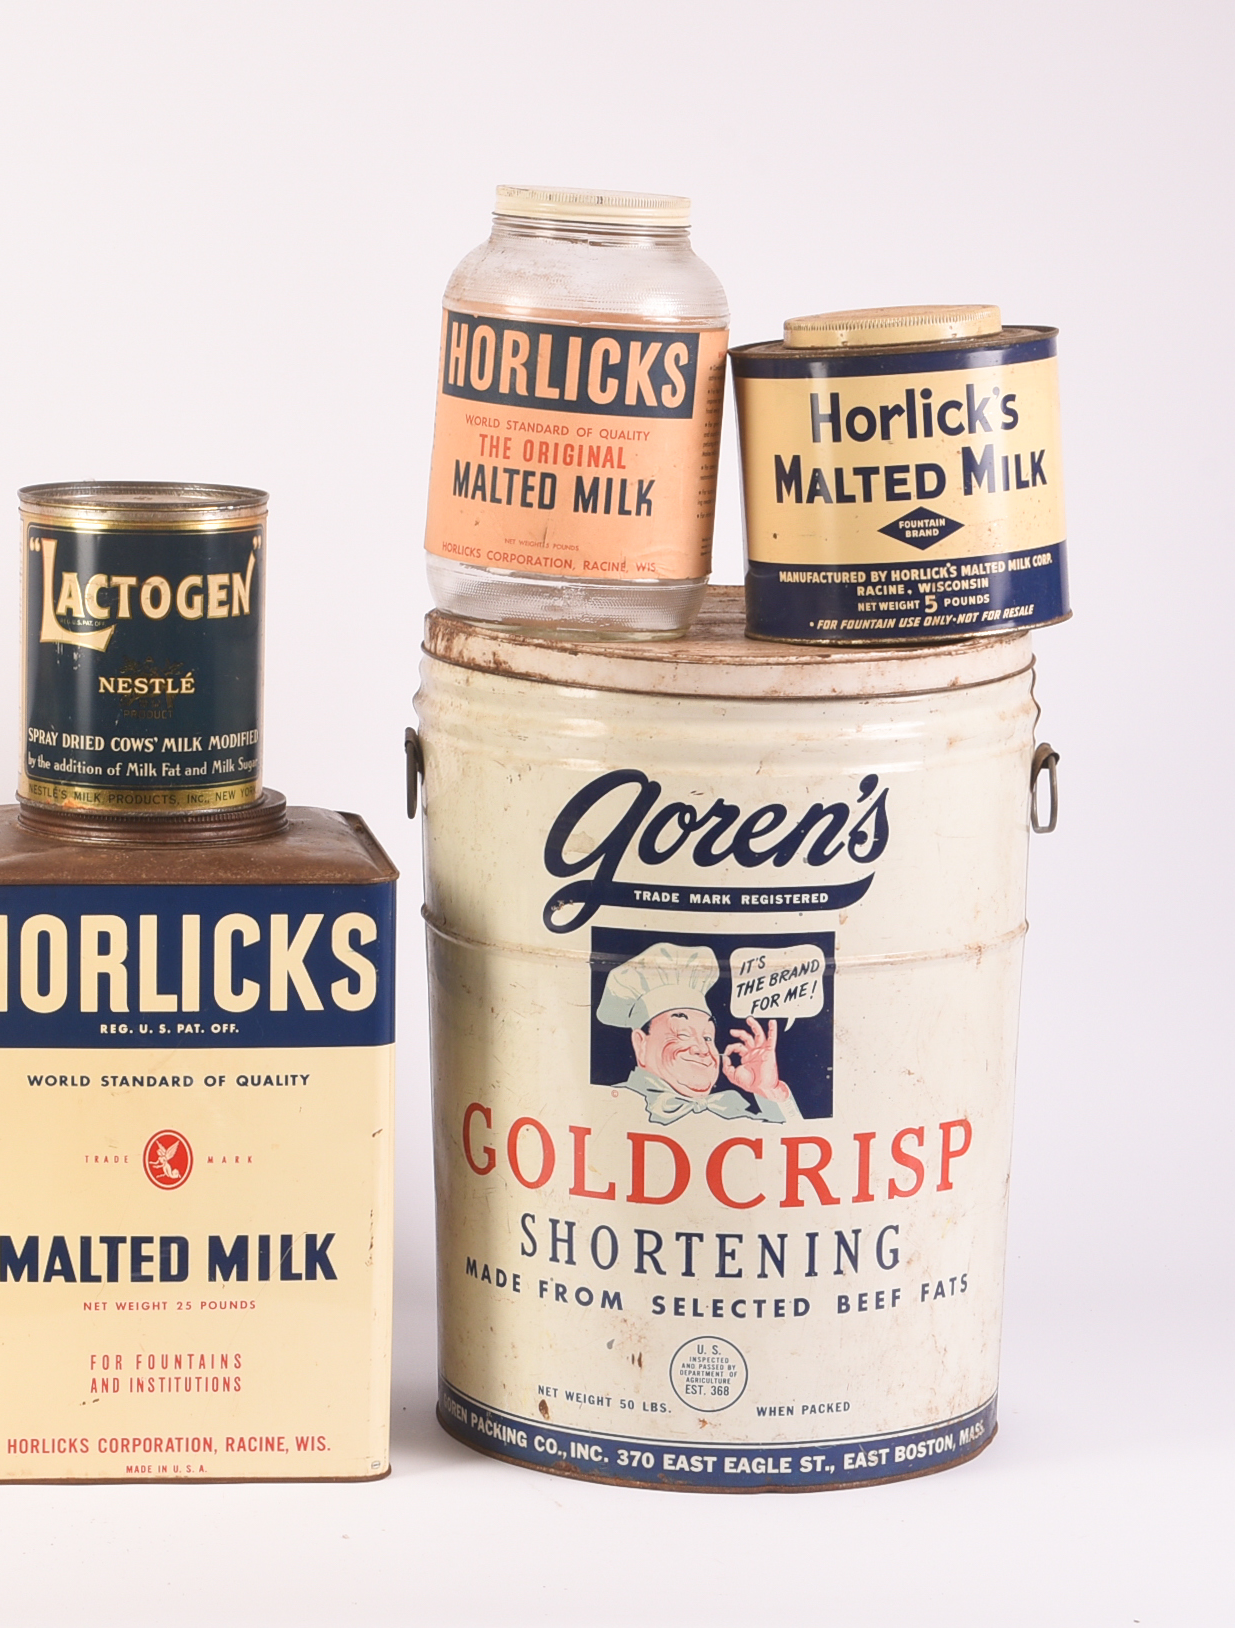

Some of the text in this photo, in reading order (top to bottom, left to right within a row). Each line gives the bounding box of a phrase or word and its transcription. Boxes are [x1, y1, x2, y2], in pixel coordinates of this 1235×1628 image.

[448, 321, 689, 408] HORLICKS
[810, 384, 1019, 443] Horlick's
[465, 413, 650, 441] WORLD STANDARD OF QUALITY
[479, 433, 626, 469] THE ORIGINAL
[774, 444, 1048, 504] MALTED MILK
[452, 459, 655, 516] MALTED MILK
[898, 519, 946, 529] FOUNTAIN
[905, 528, 939, 538] BRAND
[779, 553, 1053, 583] MANUFACTURED BY HORLICK'S MALTED MILK CORP.
[918, 578, 989, 593] WISCONSIN
[858, 594, 990, 613] NET WEIGHT 5 POUNDS
[817, 619, 837, 630] FOR
[839, 618, 897, 629] FOUNTAIN
[899, 617, 920, 628] USE
[981, 611, 1001, 621] FOR
[1003, 604, 1034, 619] RESALE
[98, 672, 196, 694] NESTLÉ
[28, 727, 259, 753] SPRAY DRIED COWS' MILK MODIFIED
[27, 750, 259, 777] by the addition of Milk Fat and Milk Sugar
[634, 890, 829, 905] TRADE MARK REGISTERED
[739, 955, 766, 975] IT'S
[736, 959, 820, 998] THE BRAND
[751, 994, 780, 1014] FOR
[27, 1074, 311, 1088] WORLD STANDARD OF QUALITY
[463, 1102, 973, 1209] GOLDCRISP
[208, 1232, 338, 1283] MILK
[520, 1212, 901, 1279] SHORTENING
[465, 1256, 969, 1318] MADE FROM SELECTED BEEF FATS
[83, 1300, 256, 1311] NET WEIGHT 25 POUNDS
[90, 1353, 242, 1370] FOR FOUNTAINS
[689, 1356, 730, 1364] INSPECTED
[90, 1377, 242, 1393] AND INSTITUTIONS
[685, 1376, 731, 1385] AGRICULTURE
[685, 1385, 729, 1396] EST. 368
[538, 1385, 672, 1414] NET WEIGHT 50 LBS.
[756, 1401, 850, 1417] WHEN PACKED
[471, 1412, 527, 1448] PACKING
[617, 1450, 654, 1468] 370
[663, 1454, 717, 1473] EAST
[724, 1457, 792, 1474] EAGLE
[843, 1449, 890, 1470] EAST
